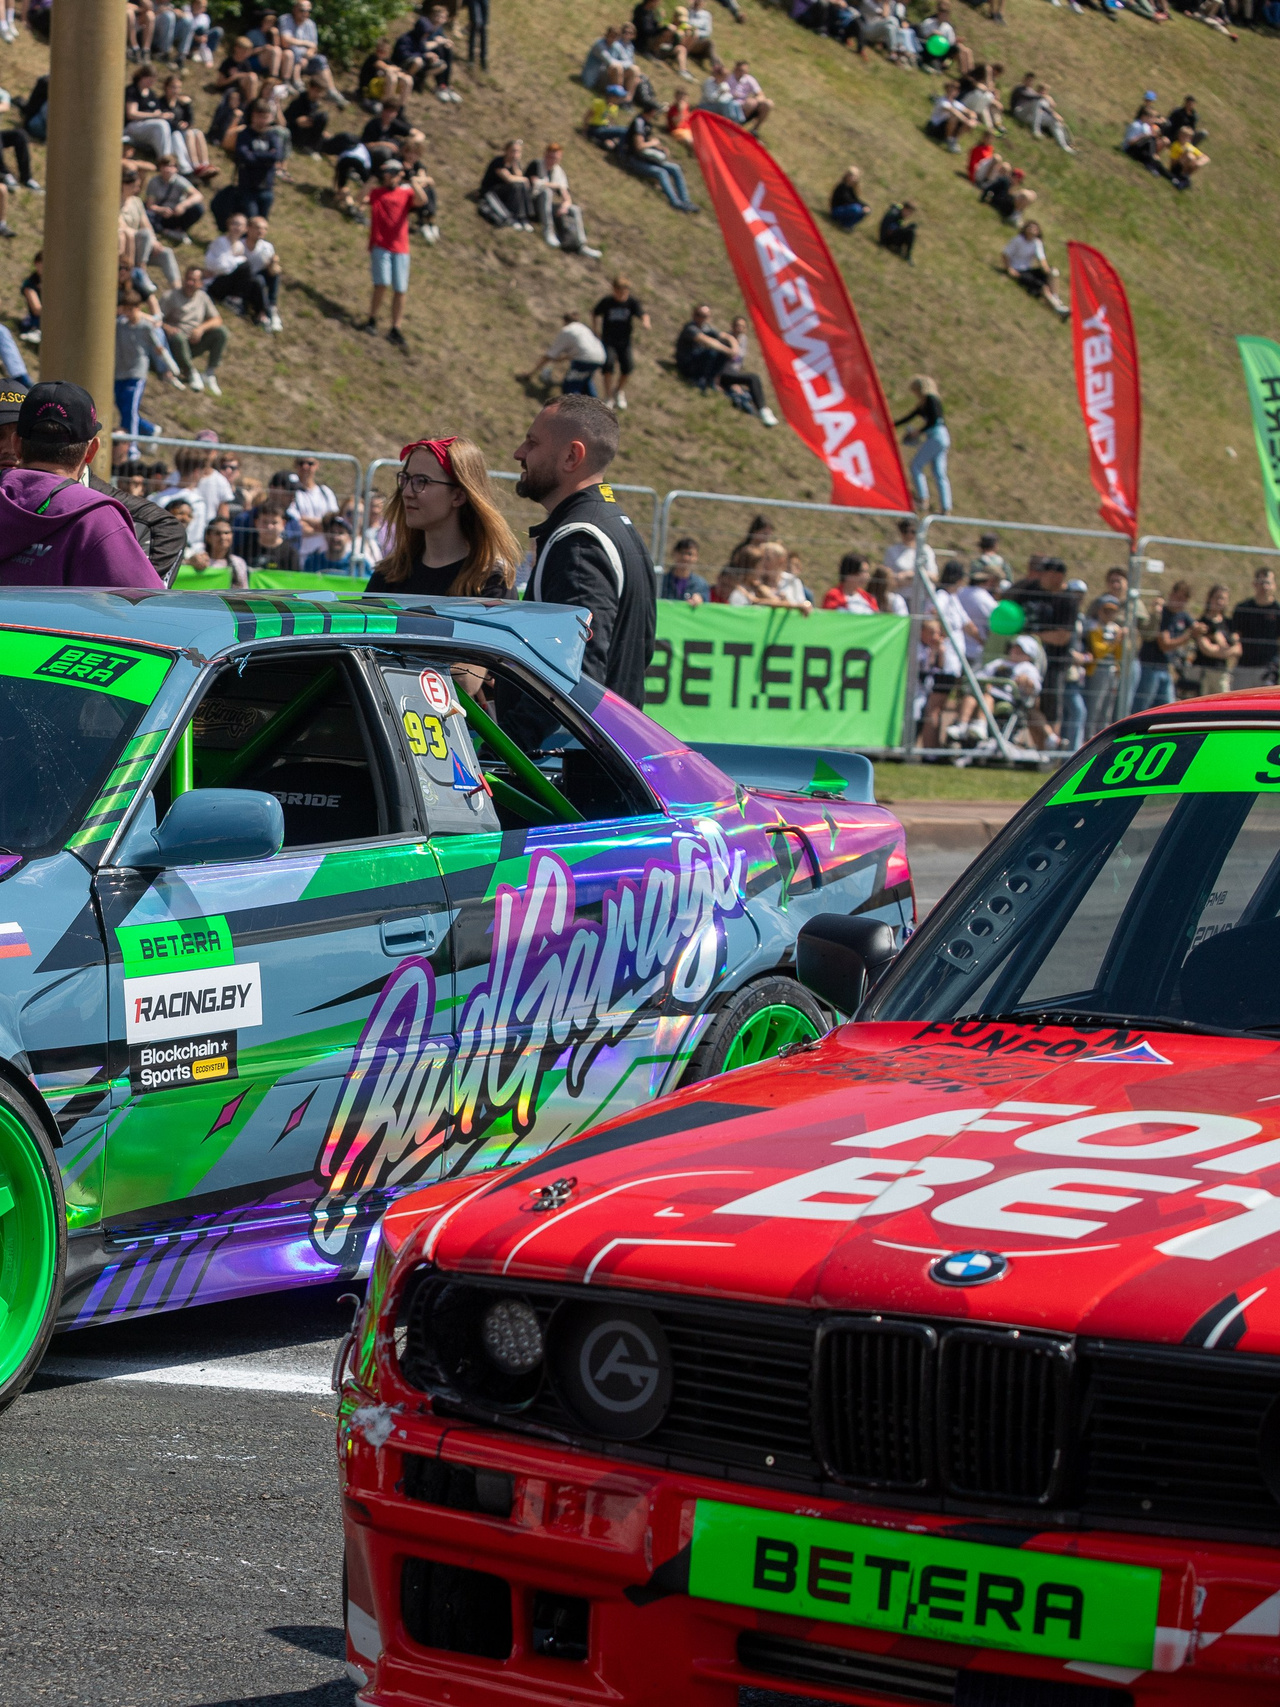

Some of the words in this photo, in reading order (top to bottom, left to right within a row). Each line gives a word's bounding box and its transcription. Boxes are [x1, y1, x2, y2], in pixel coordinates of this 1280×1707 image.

[61, 647, 129, 668] BET
[426, 678, 442, 703] E
[402, 709, 449, 761] 93
[1102, 741, 1177, 785] 80
[139, 930, 222, 960] BET.ERA
[140, 1039, 219, 1066] Blockchain
[140, 1064, 191, 1087] Sports
[195, 1062, 225, 1074] ECOSYSTEM
[831, 1100, 1280, 1174] FO
